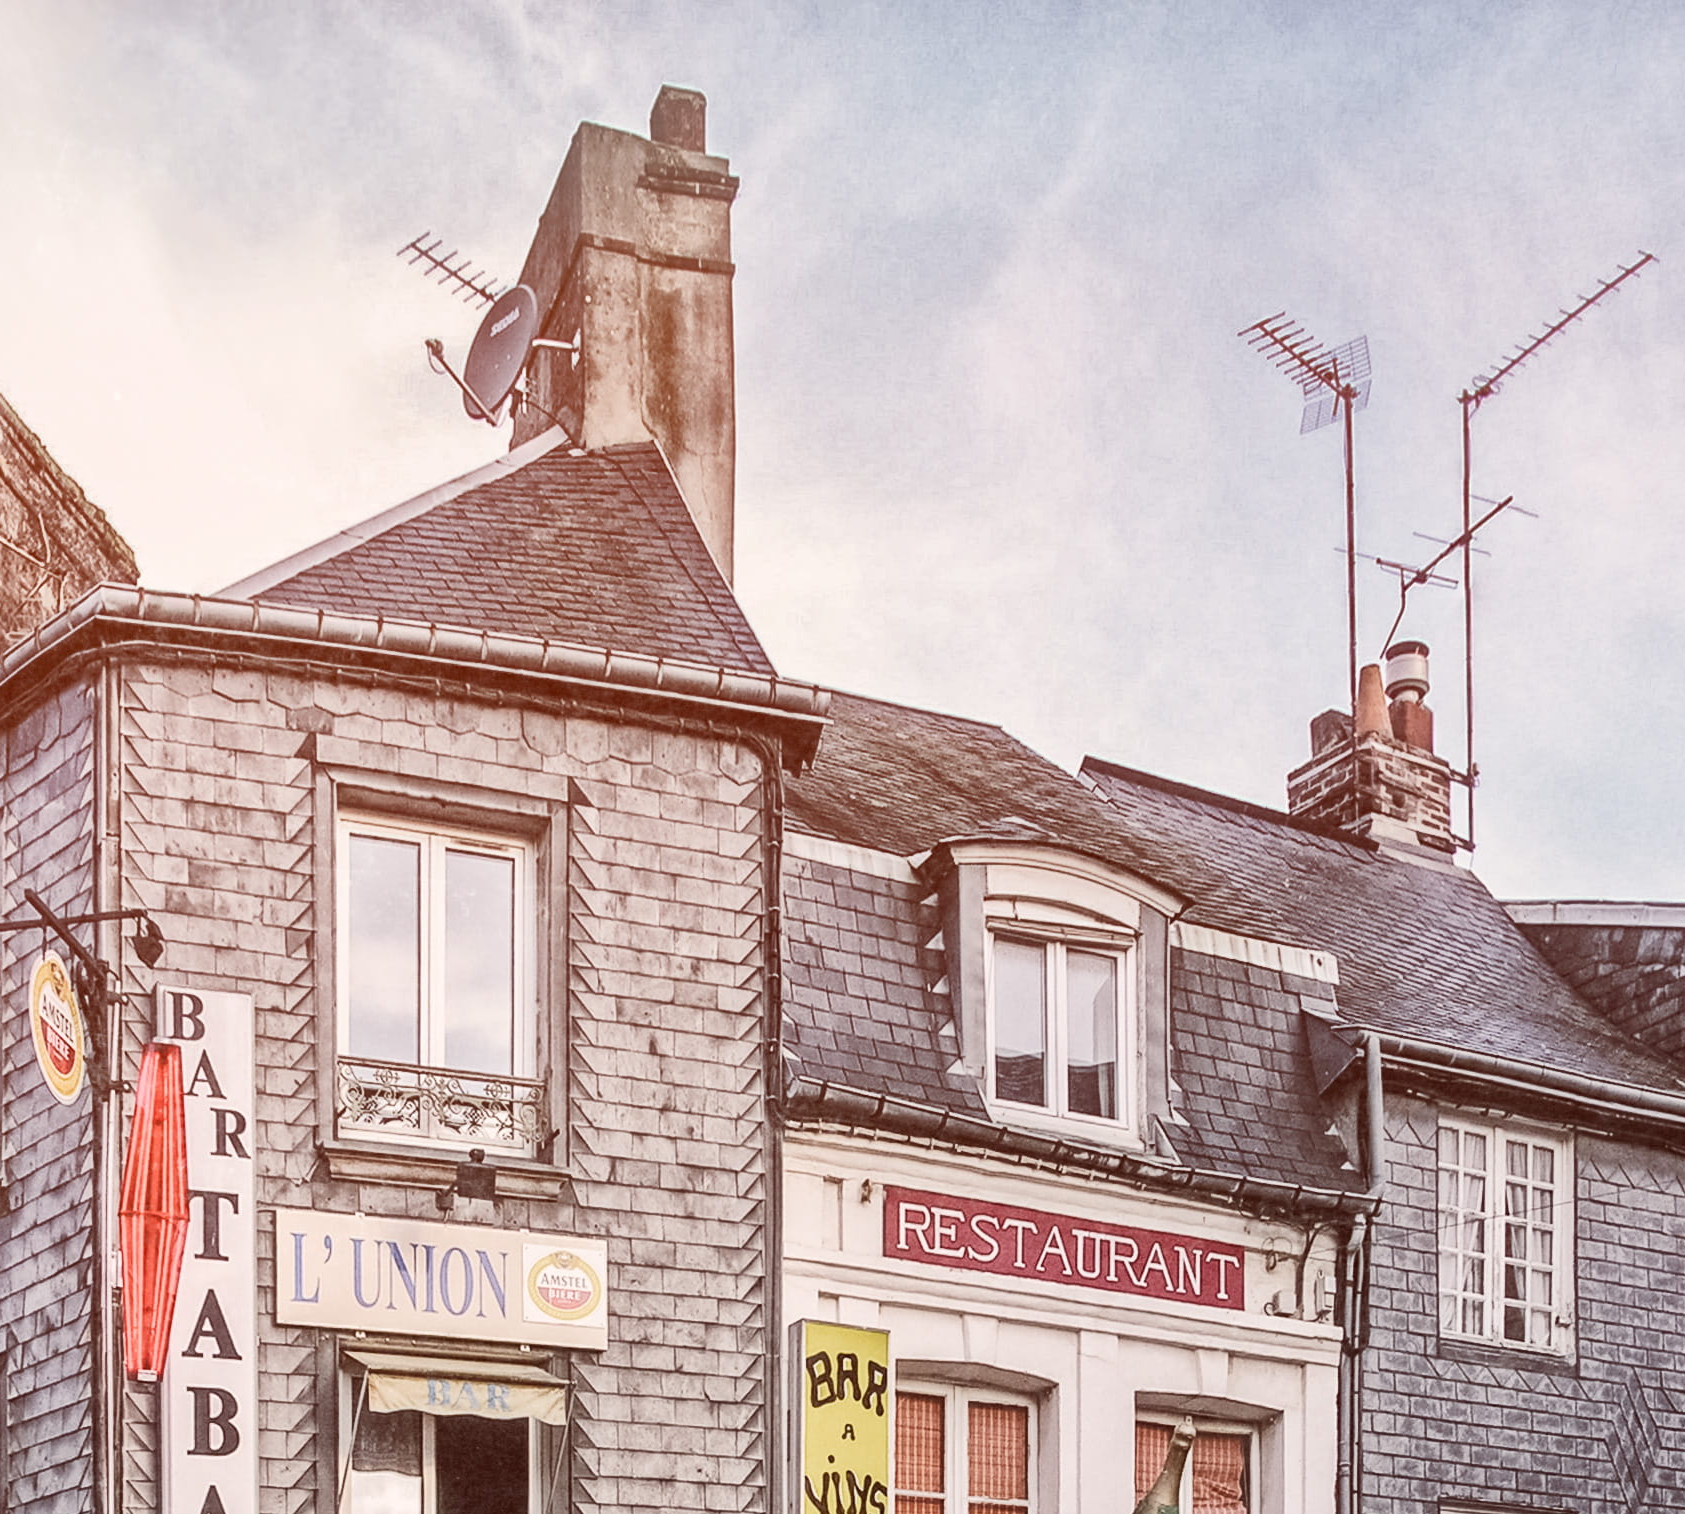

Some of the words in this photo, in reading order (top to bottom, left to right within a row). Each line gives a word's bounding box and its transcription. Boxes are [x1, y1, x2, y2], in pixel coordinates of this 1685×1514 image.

[43, 993, 74, 1043] AMSTEL
[167, 993, 251, 1160] BAR
[896, 1200, 1240, 1301] RESTAURANT
[541, 1272, 588, 1289] AMSTEL
[427, 1378, 512, 1413] BAR
[805, 1351, 888, 1417] BAR
[842, 1423, 856, 1441] A
